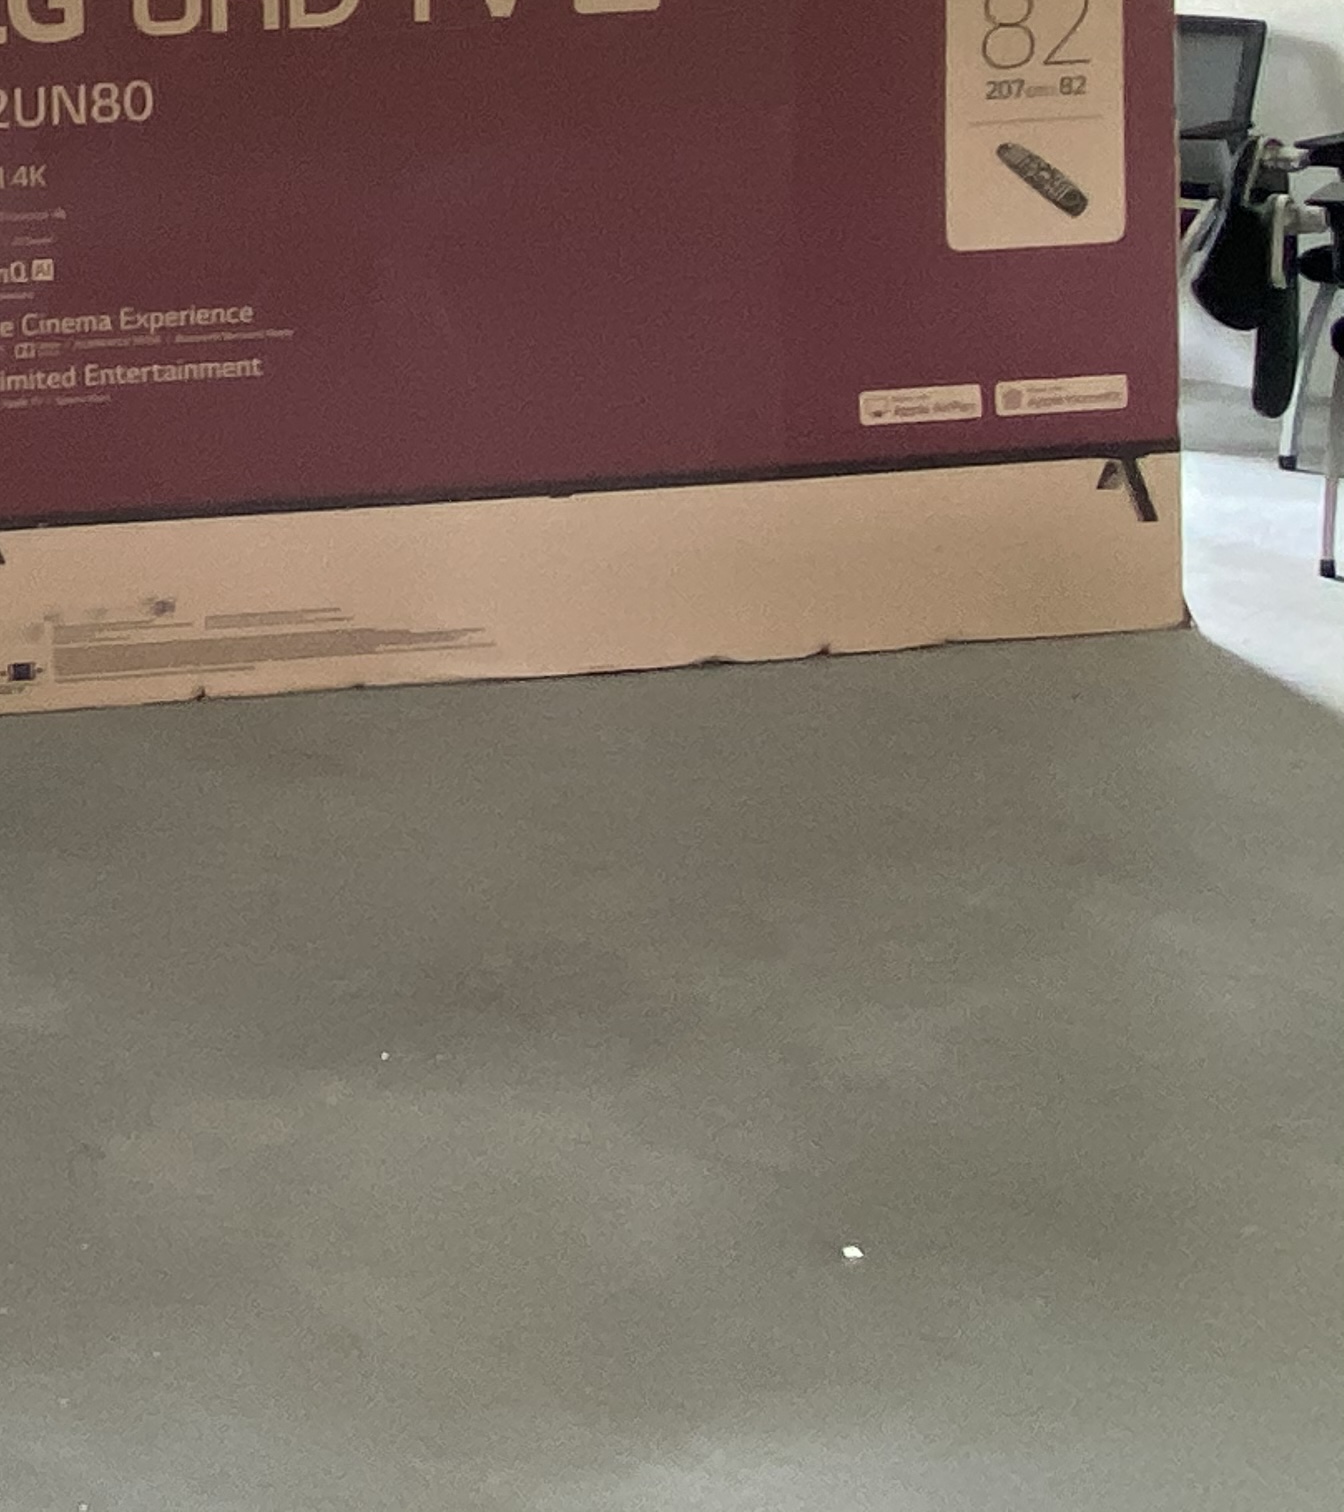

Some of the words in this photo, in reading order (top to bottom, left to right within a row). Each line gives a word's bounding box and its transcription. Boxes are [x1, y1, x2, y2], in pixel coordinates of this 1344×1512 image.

[985, 78, 1026, 101] 207
[1059, 75, 1087, 96] 82
[11, 164, 48, 188] 4K
[21, 312, 112, 337] Cinema
[119, 305, 254, 334] Experience
[84, 357, 264, 388] Entertainment
